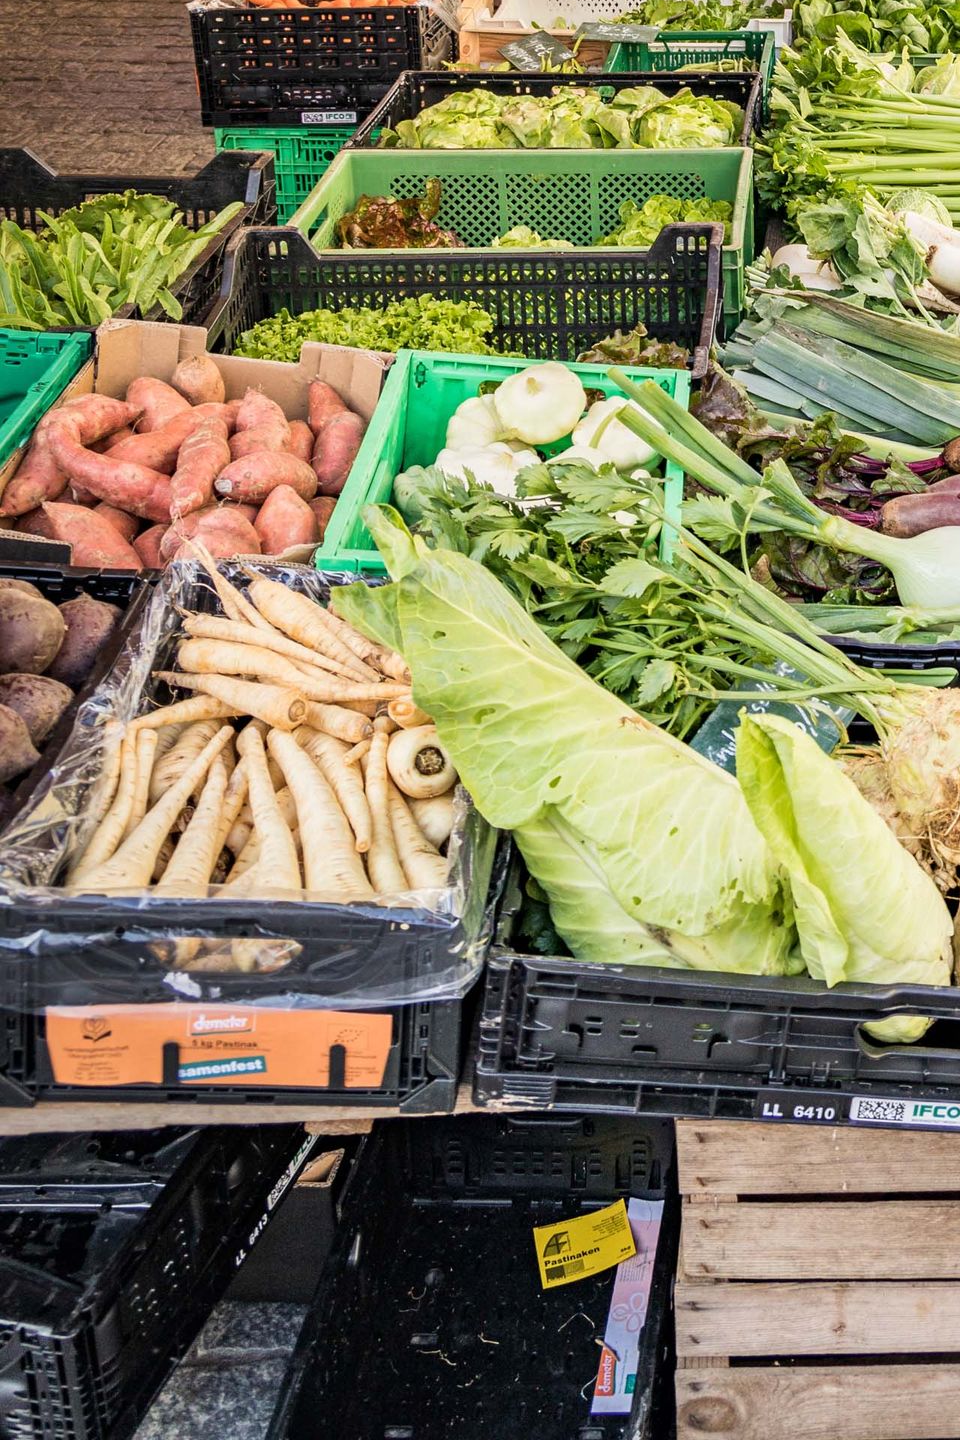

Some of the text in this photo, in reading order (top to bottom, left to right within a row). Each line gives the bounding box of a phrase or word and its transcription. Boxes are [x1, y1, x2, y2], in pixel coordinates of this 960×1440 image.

[193, 1015, 248, 1030] demeter
[200, 1039, 213, 1049] kg
[762, 1103, 835, 1120] LL 6410
[912, 1104, 960, 1119] IFCO
[249, 1213, 268, 1245] 6413
[544, 1246, 600, 1267] Pastinaken
[598, 1355, 612, 1392] demeter
